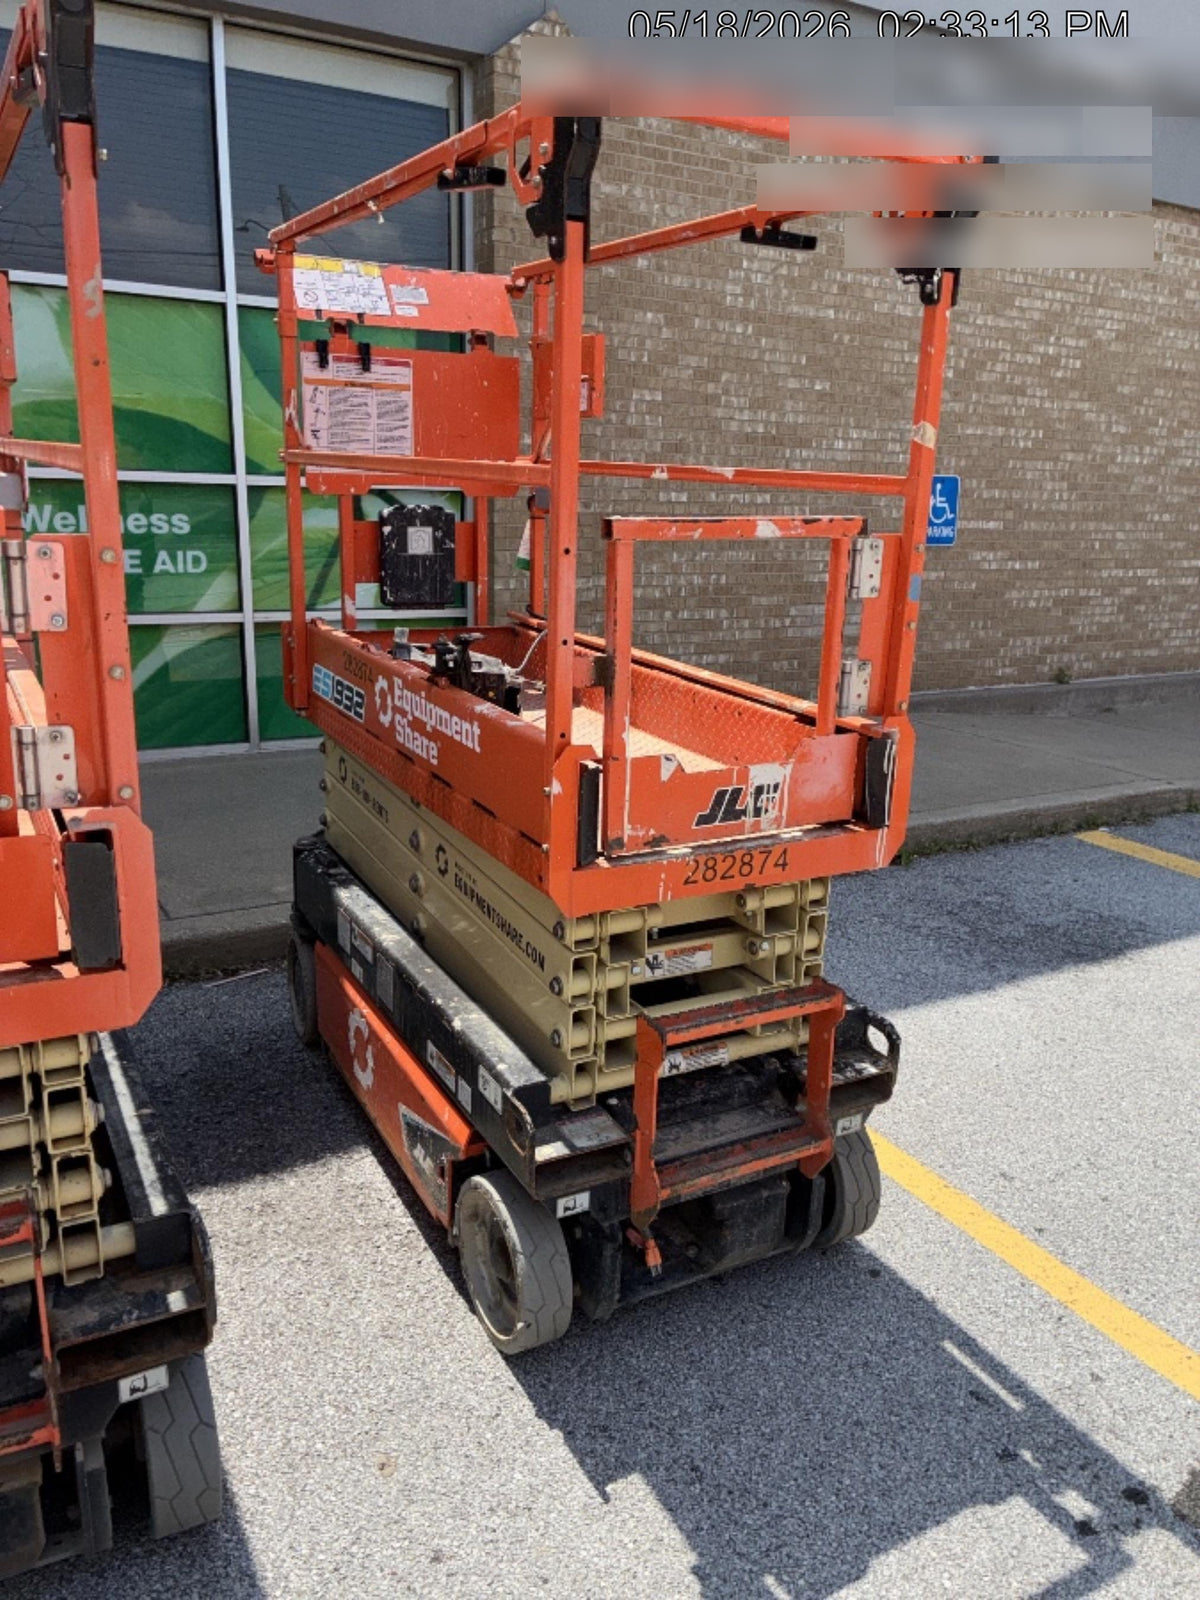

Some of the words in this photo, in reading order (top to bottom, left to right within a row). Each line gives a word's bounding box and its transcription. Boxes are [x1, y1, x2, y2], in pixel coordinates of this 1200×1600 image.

[20, 504, 191, 534] Weless
[152, 550, 208, 574] AID
[393, 677, 481, 753] Equipment
[394, 713, 439, 766] Share
[682, 847, 789, 886] 282874
